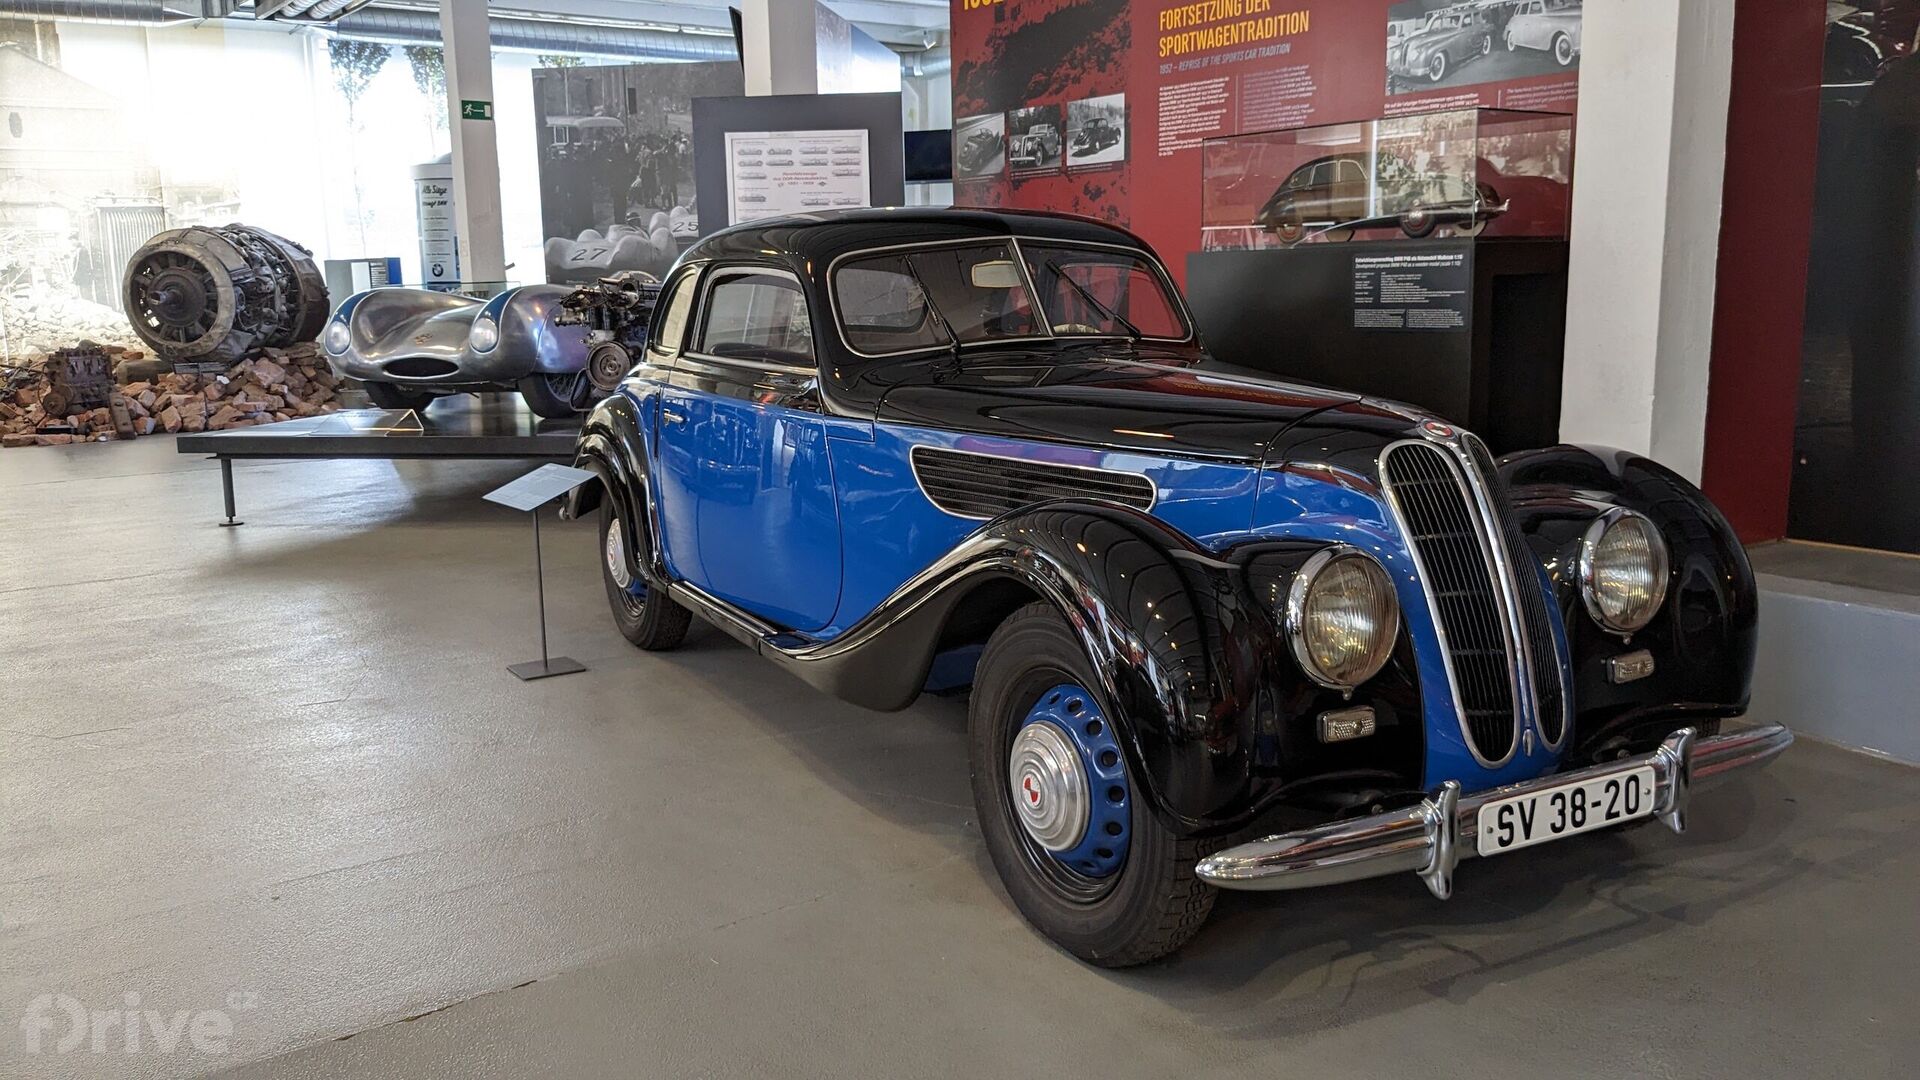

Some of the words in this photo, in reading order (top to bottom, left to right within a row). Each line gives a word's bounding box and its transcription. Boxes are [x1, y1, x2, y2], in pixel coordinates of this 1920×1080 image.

[1160, 0, 1242, 31] FORTSETZUNG
[1245, 0, 1271, 14] DER
[1159, 10, 1310, 57] SPORTWAGENTRADITION
[1179, 58, 1201, 71] REPRISE
[1202, 56, 1209, 67] OF
[1210, 54, 1221, 66] THE
[1222, 51, 1244, 64] SPORTS
[1245, 48, 1257, 60] CAR
[1258, 42, 1291, 58] TRADITION
[672, 221, 699, 233] 25
[571, 247, 608, 261] 27
[1497, 798, 1537, 847] SV
[1549, 774, 1640, 834] 38-20
